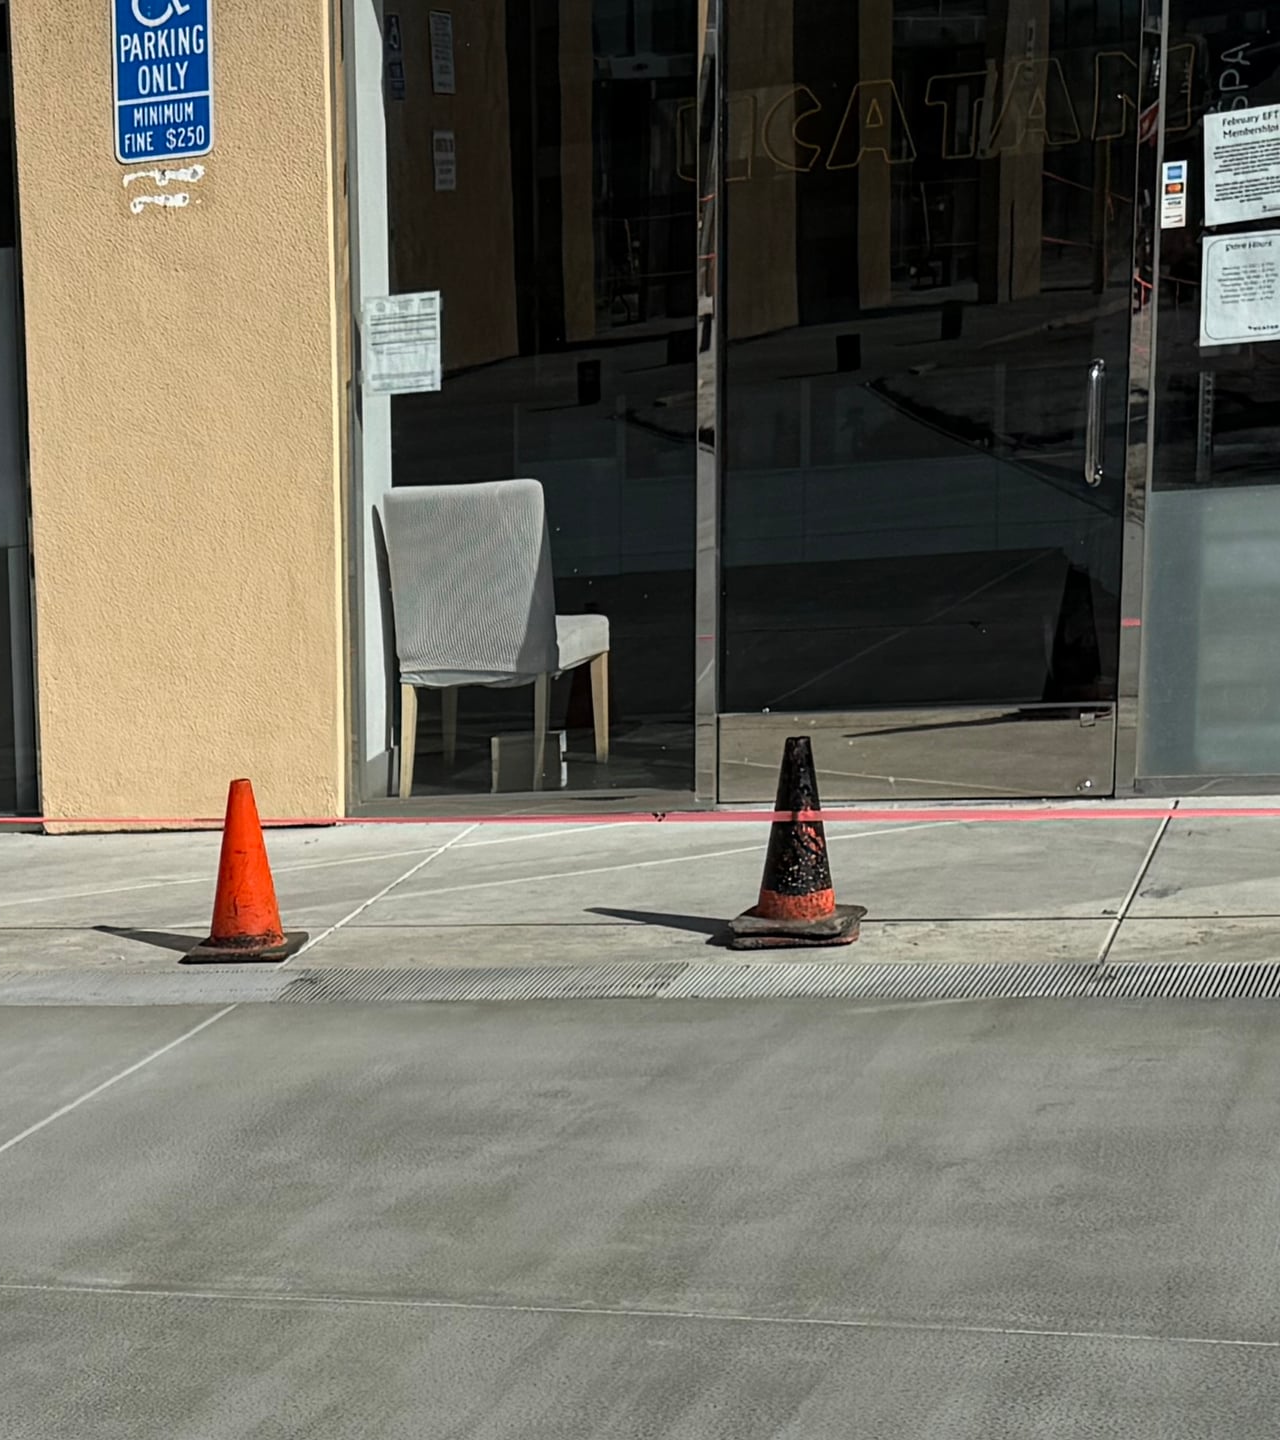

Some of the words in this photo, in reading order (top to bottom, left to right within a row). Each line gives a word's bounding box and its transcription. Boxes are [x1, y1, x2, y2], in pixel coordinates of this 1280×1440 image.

[120, 25, 204, 63] PARKING
[138, 61, 189, 95] ONLY
[134, 102, 194, 128] MINIMUM
[1222, 114, 1260, 127] February
[1262, 110, 1280, 121] EFT
[124, 131, 154, 153] FINE
[166, 125, 205, 150] $250
